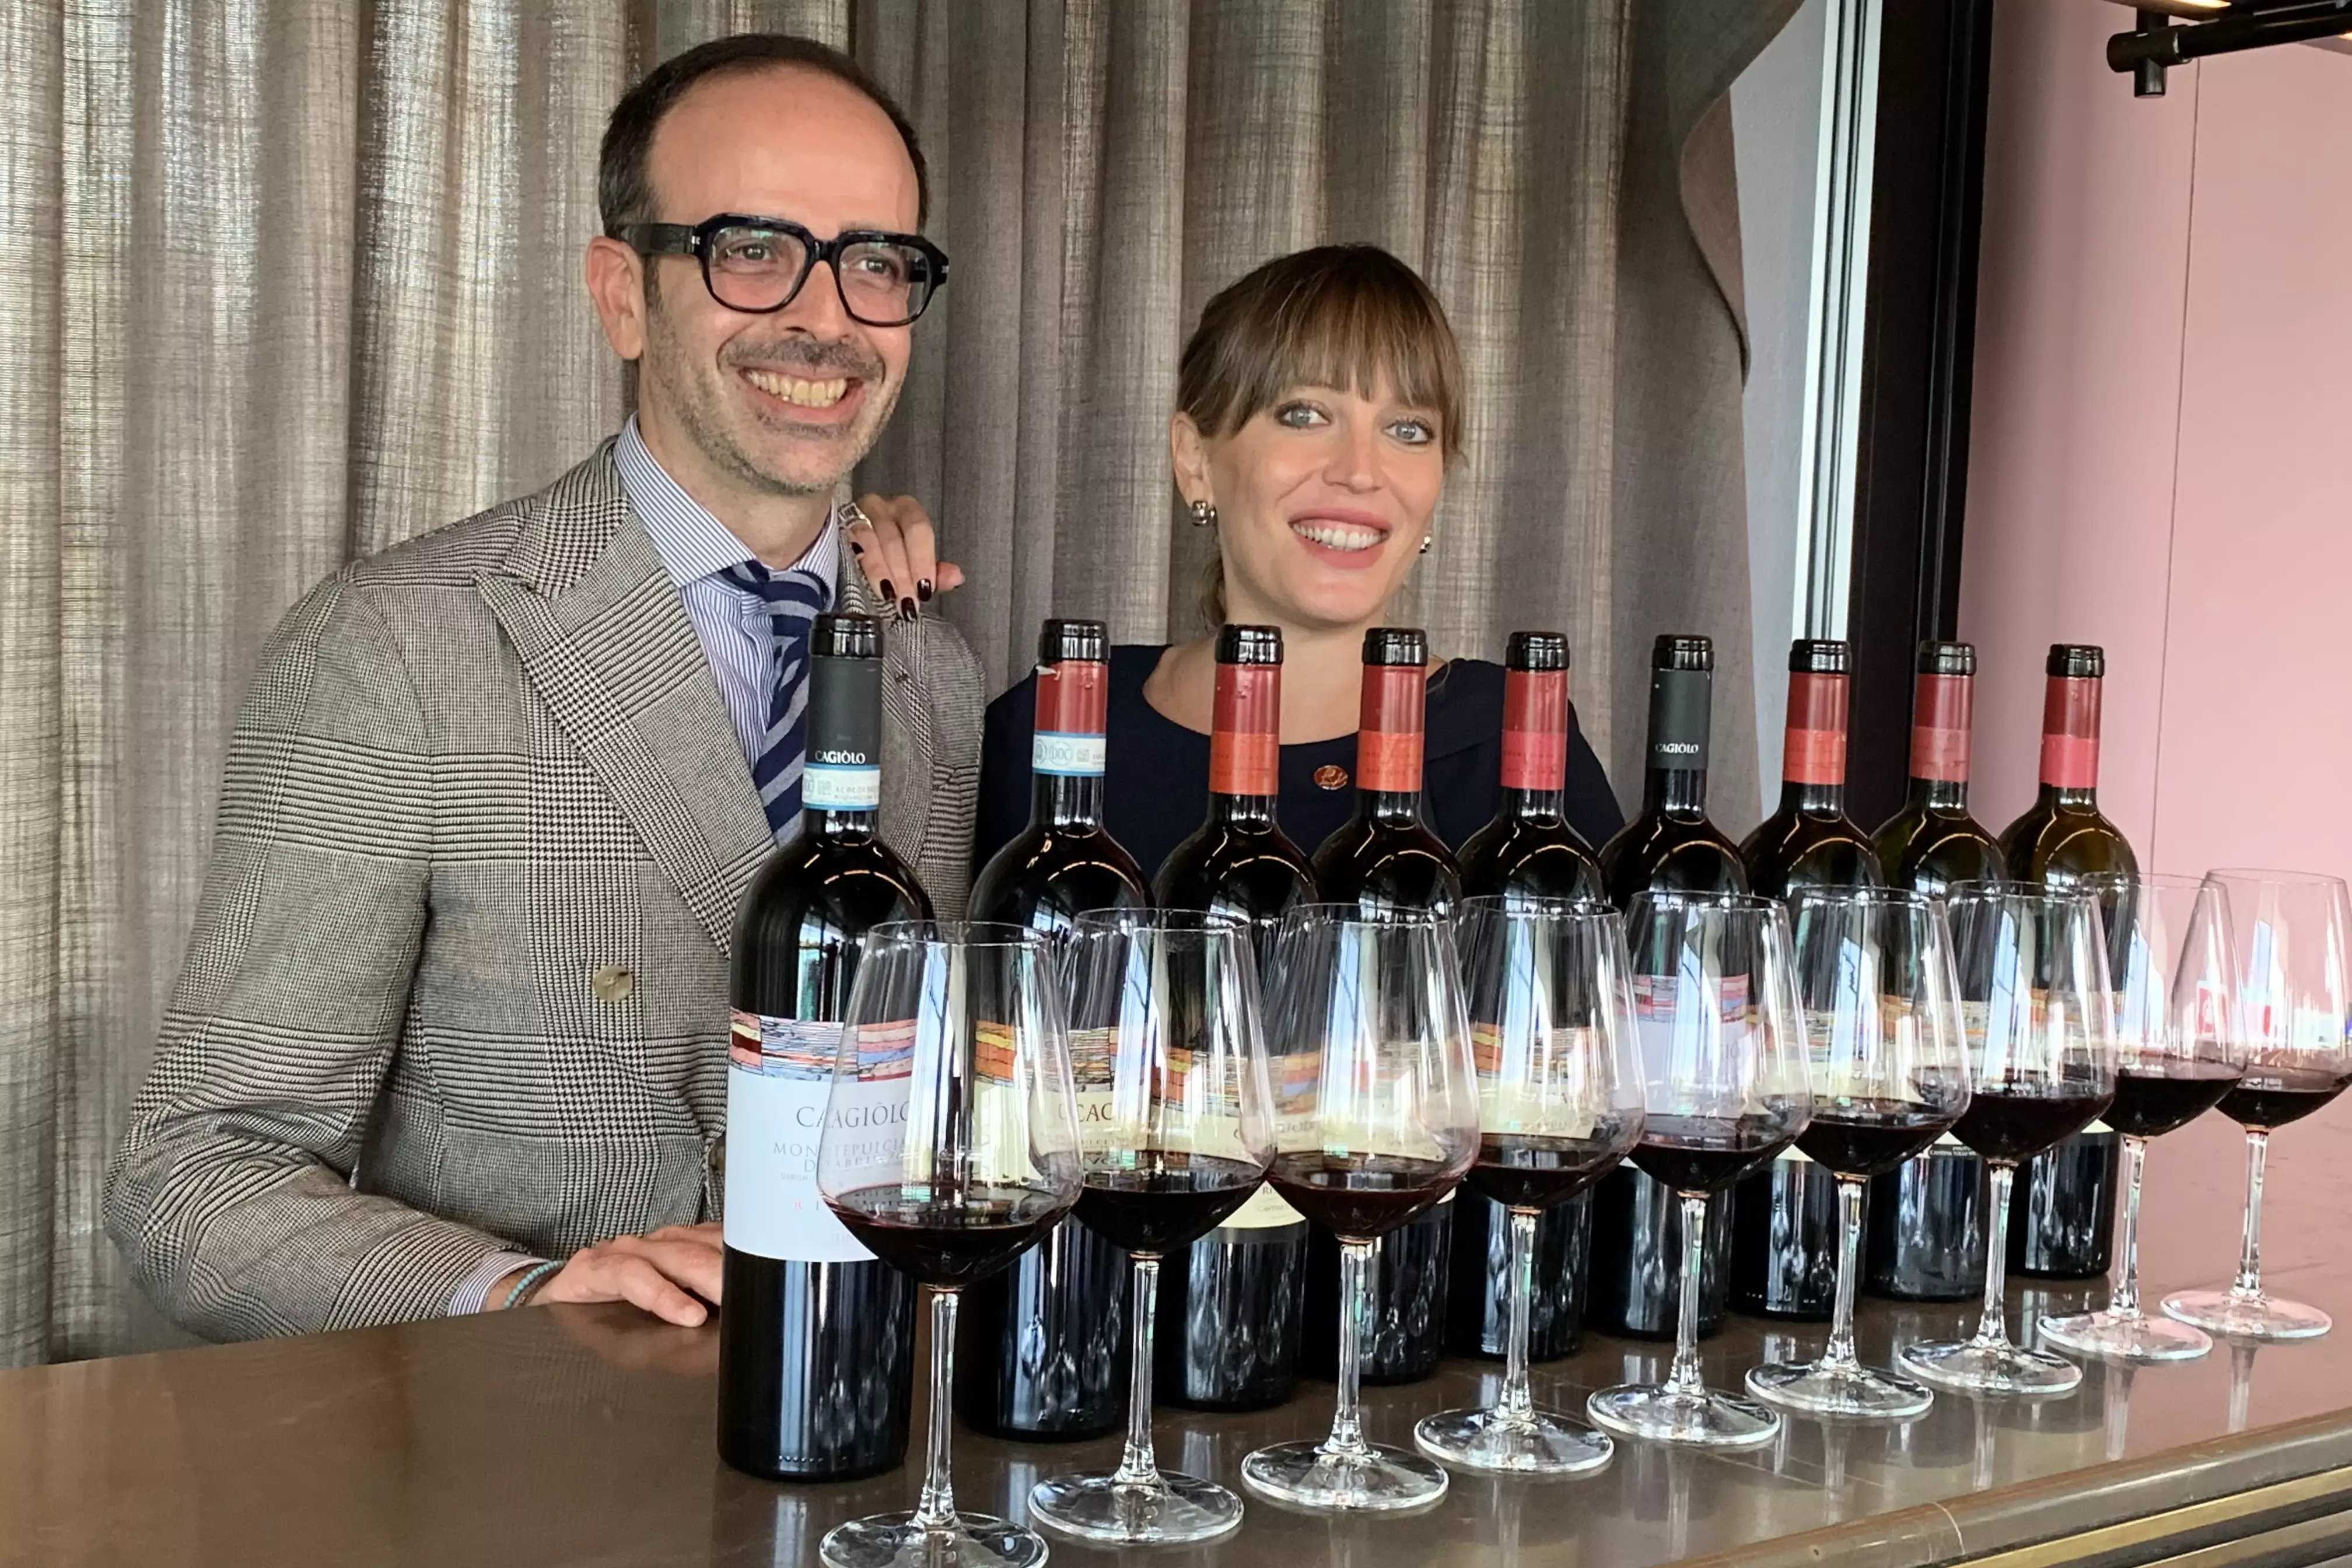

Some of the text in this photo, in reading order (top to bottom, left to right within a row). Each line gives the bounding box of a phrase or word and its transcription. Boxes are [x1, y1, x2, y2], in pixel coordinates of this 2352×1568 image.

[1052, 747, 1069, 760] DOC
[1655, 742, 1699, 754] CAGIÒLO
[814, 750, 866, 764] CAGIÒLO
